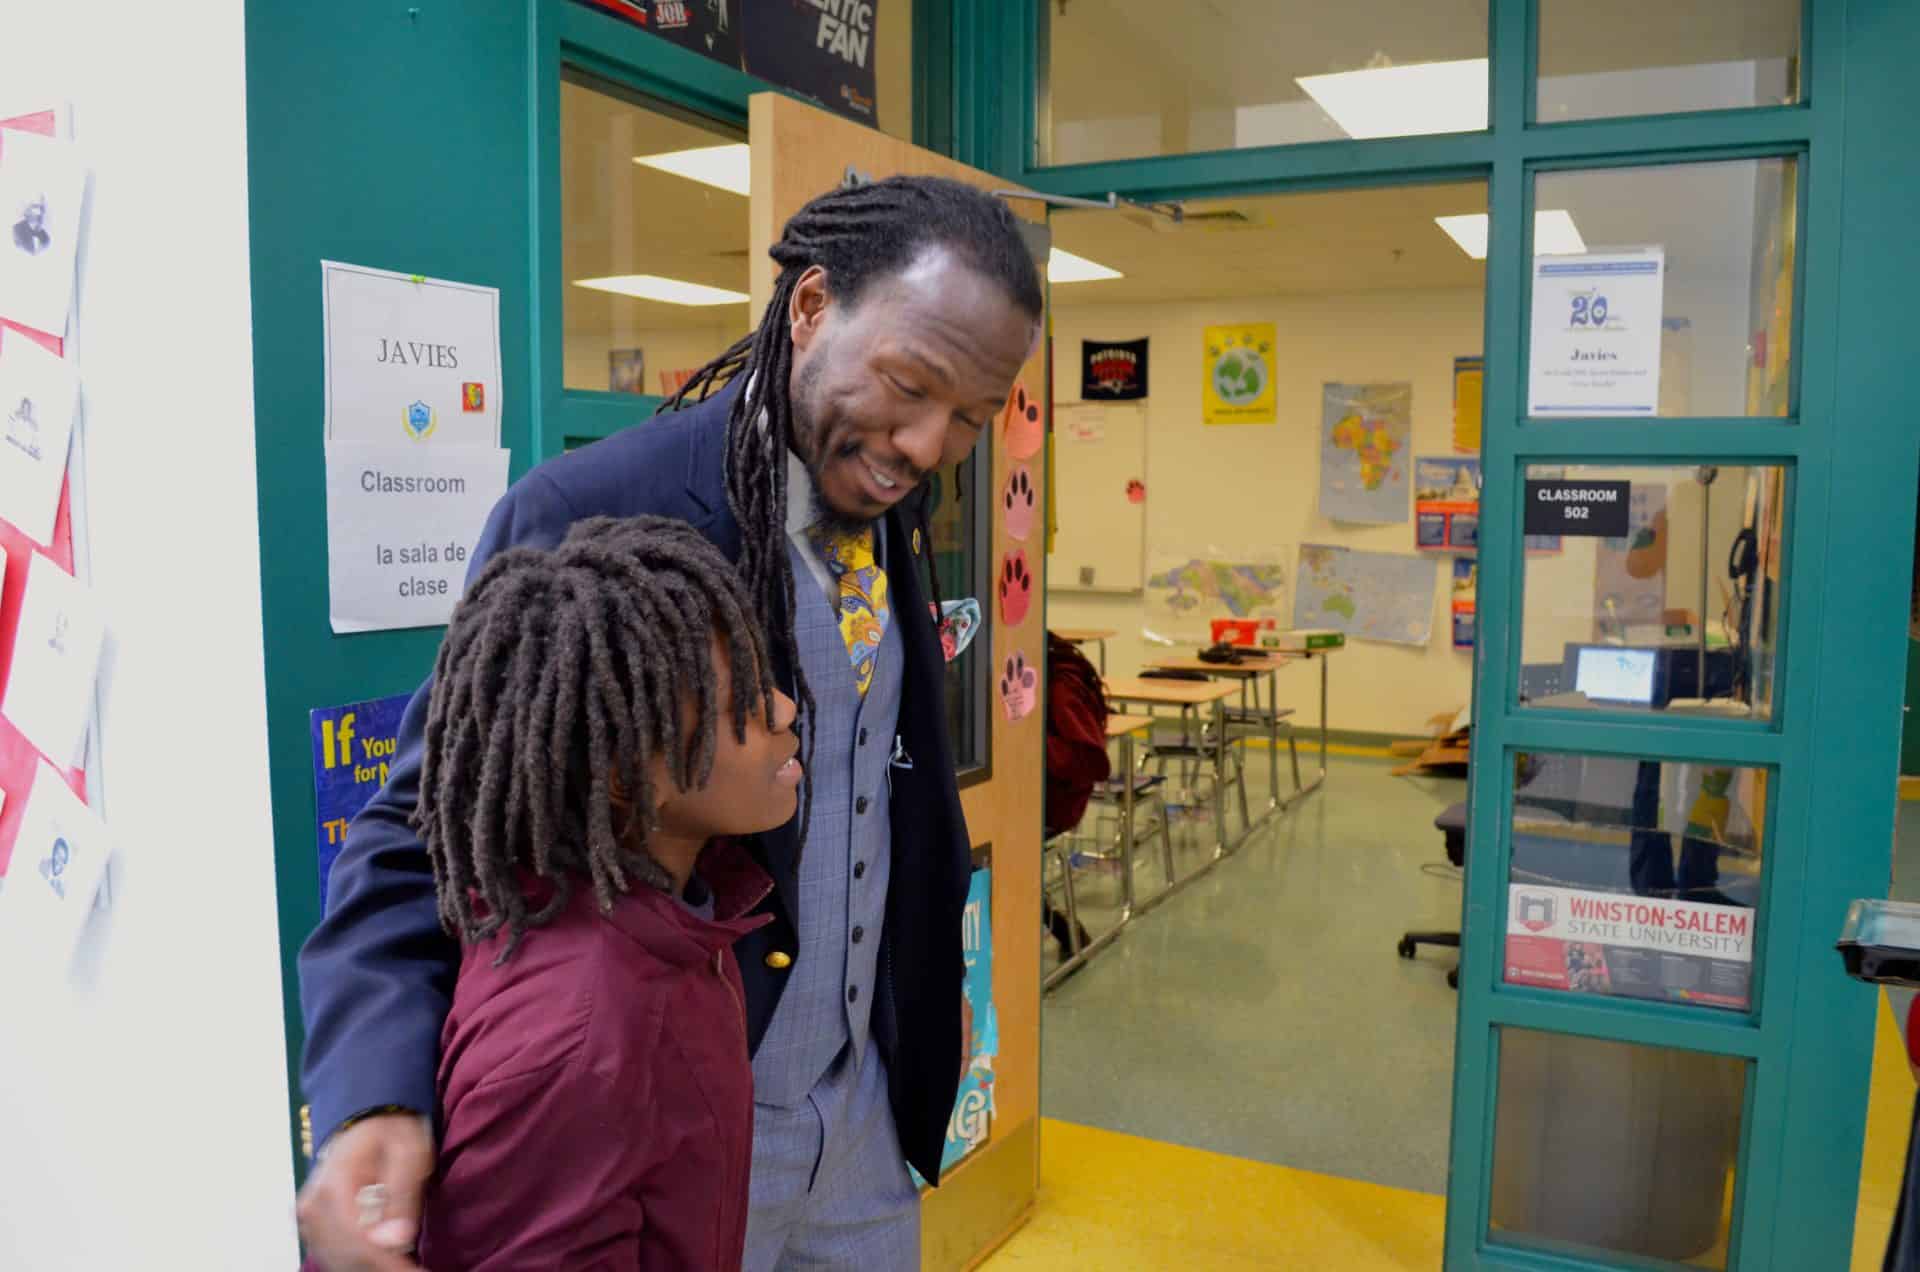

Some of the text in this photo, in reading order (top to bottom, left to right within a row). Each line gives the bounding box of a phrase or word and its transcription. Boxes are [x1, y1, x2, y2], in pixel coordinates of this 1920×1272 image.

[816, 12, 869, 68] FAN
[1570, 295, 1608, 327] 20
[377, 338, 458, 368] JAVIES
[361, 470, 465, 493] Classroom
[1537, 488, 1617, 502] CLASSROOM
[1564, 505, 1589, 519] 502
[376, 541, 466, 565] la sala de
[398, 576, 448, 597] clase
[321, 713, 356, 770] If
[354, 764, 376, 784] for
[1570, 897, 1747, 936] WINSTON-SALEM
[1569, 920, 1744, 952] STATE UNIVERSITY
